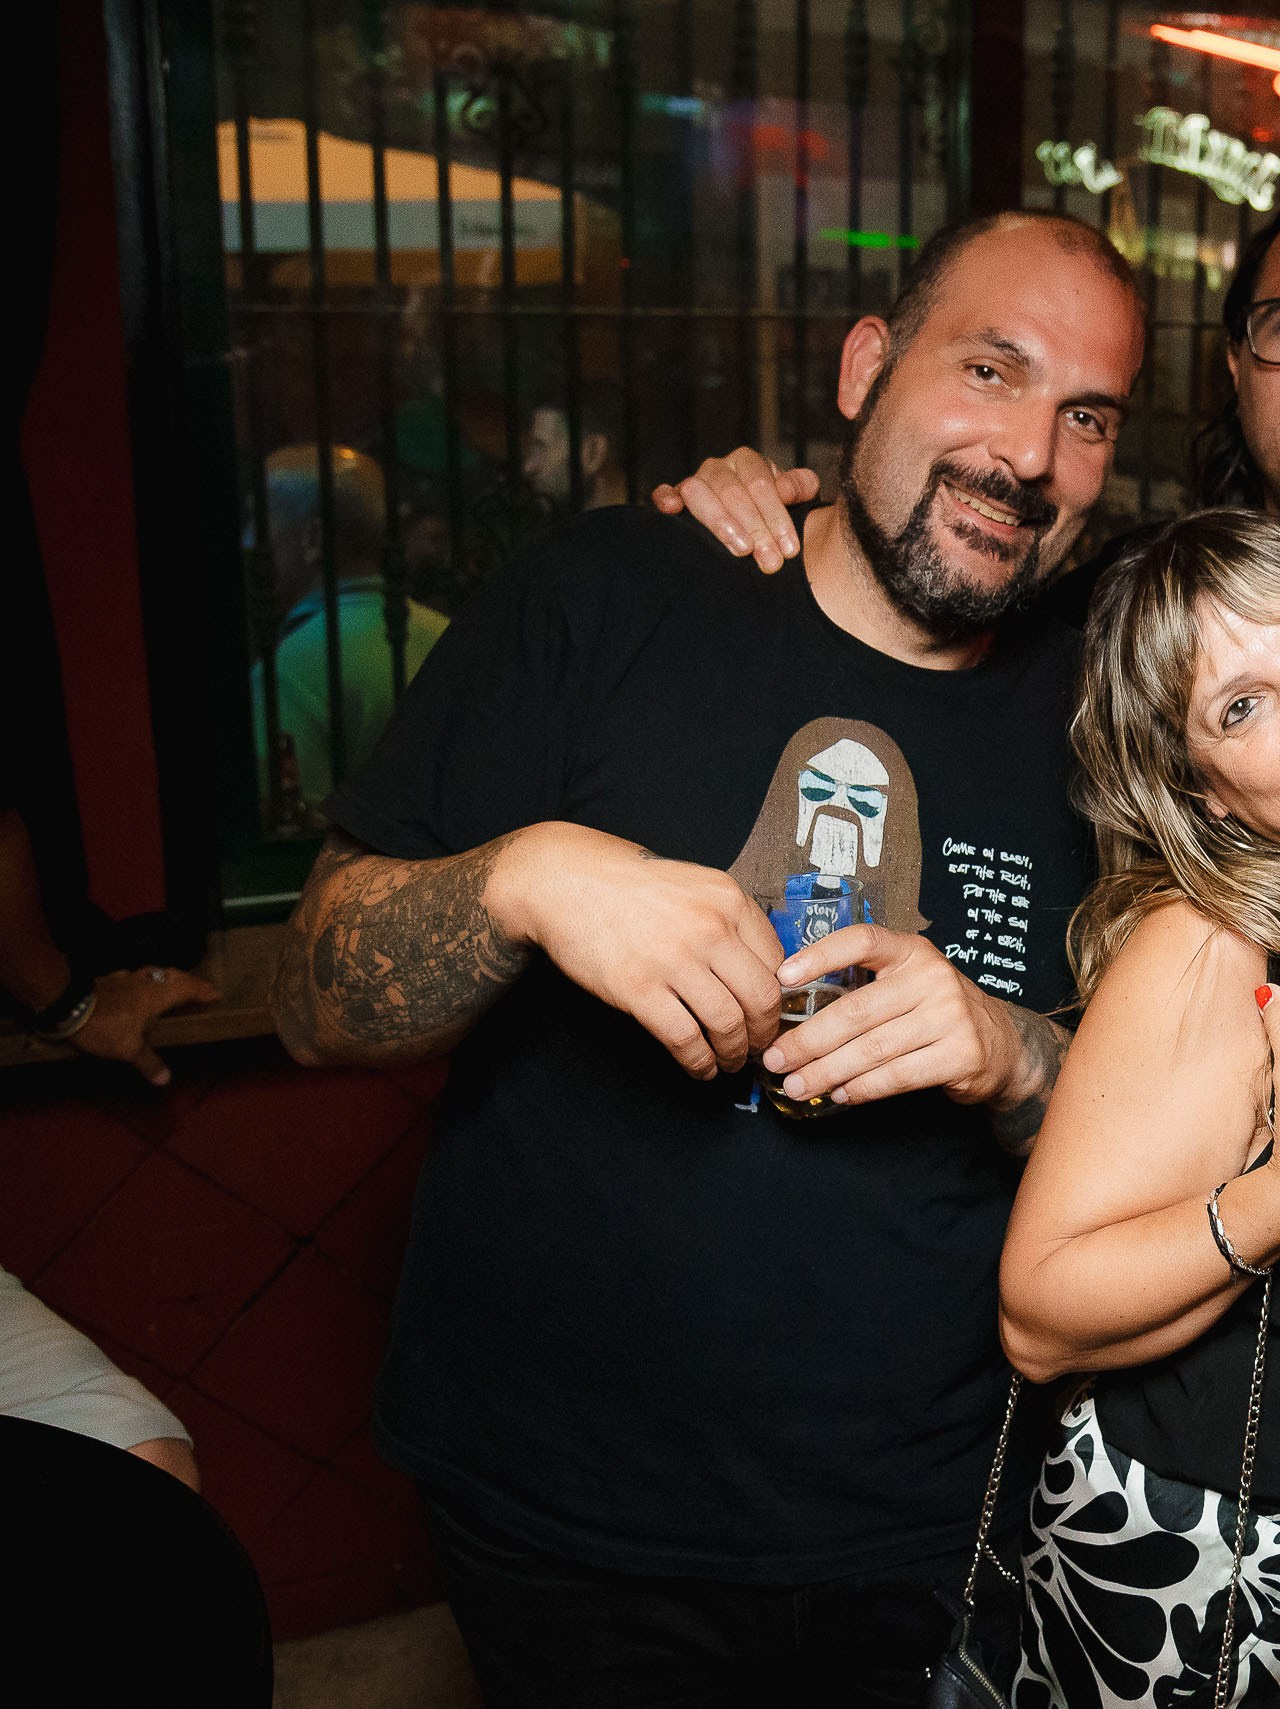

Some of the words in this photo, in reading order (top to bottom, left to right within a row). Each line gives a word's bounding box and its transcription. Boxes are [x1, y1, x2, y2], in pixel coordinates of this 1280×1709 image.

[942, 837, 976, 857] COME
[983, 848, 995, 862] ON
[1000, 852, 1033, 870] BABY,
[949, 864, 971, 874] EAT
[972, 864, 995, 881] THE
[1000, 870, 1031, 891] RICH,
[986, 888, 1006, 905] THE
[967, 908, 979, 922] ON
[982, 908, 1003, 925] THE
[1008, 916, 1028, 932] SON
[966, 929, 979, 940] OF
[984, 932, 992, 941] A
[983, 951, 1027, 972] MESS
